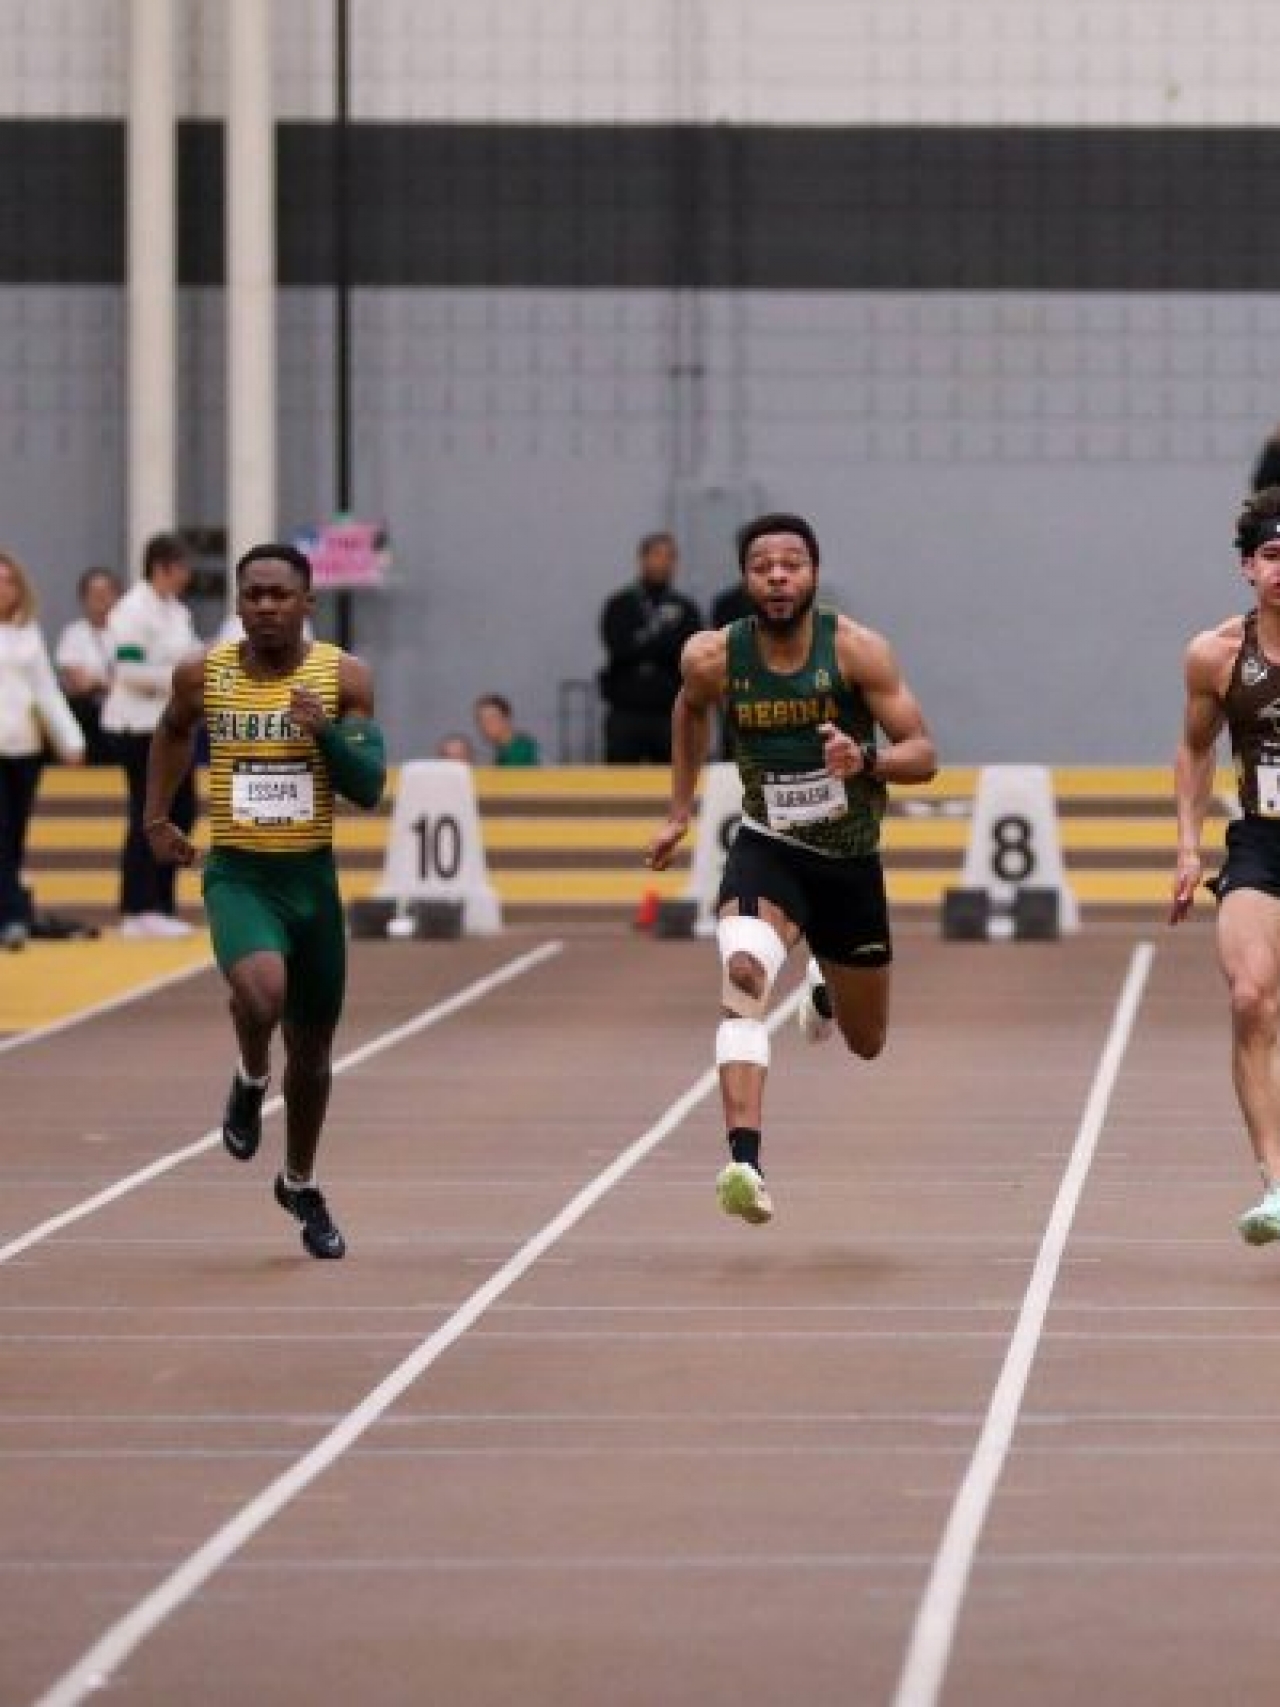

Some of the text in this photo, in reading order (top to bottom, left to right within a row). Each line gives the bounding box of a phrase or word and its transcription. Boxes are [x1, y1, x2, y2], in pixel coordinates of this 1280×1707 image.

[738, 697, 840, 728] REGINA
[409, 814, 462, 881] 10
[991, 814, 1035, 883] 8
